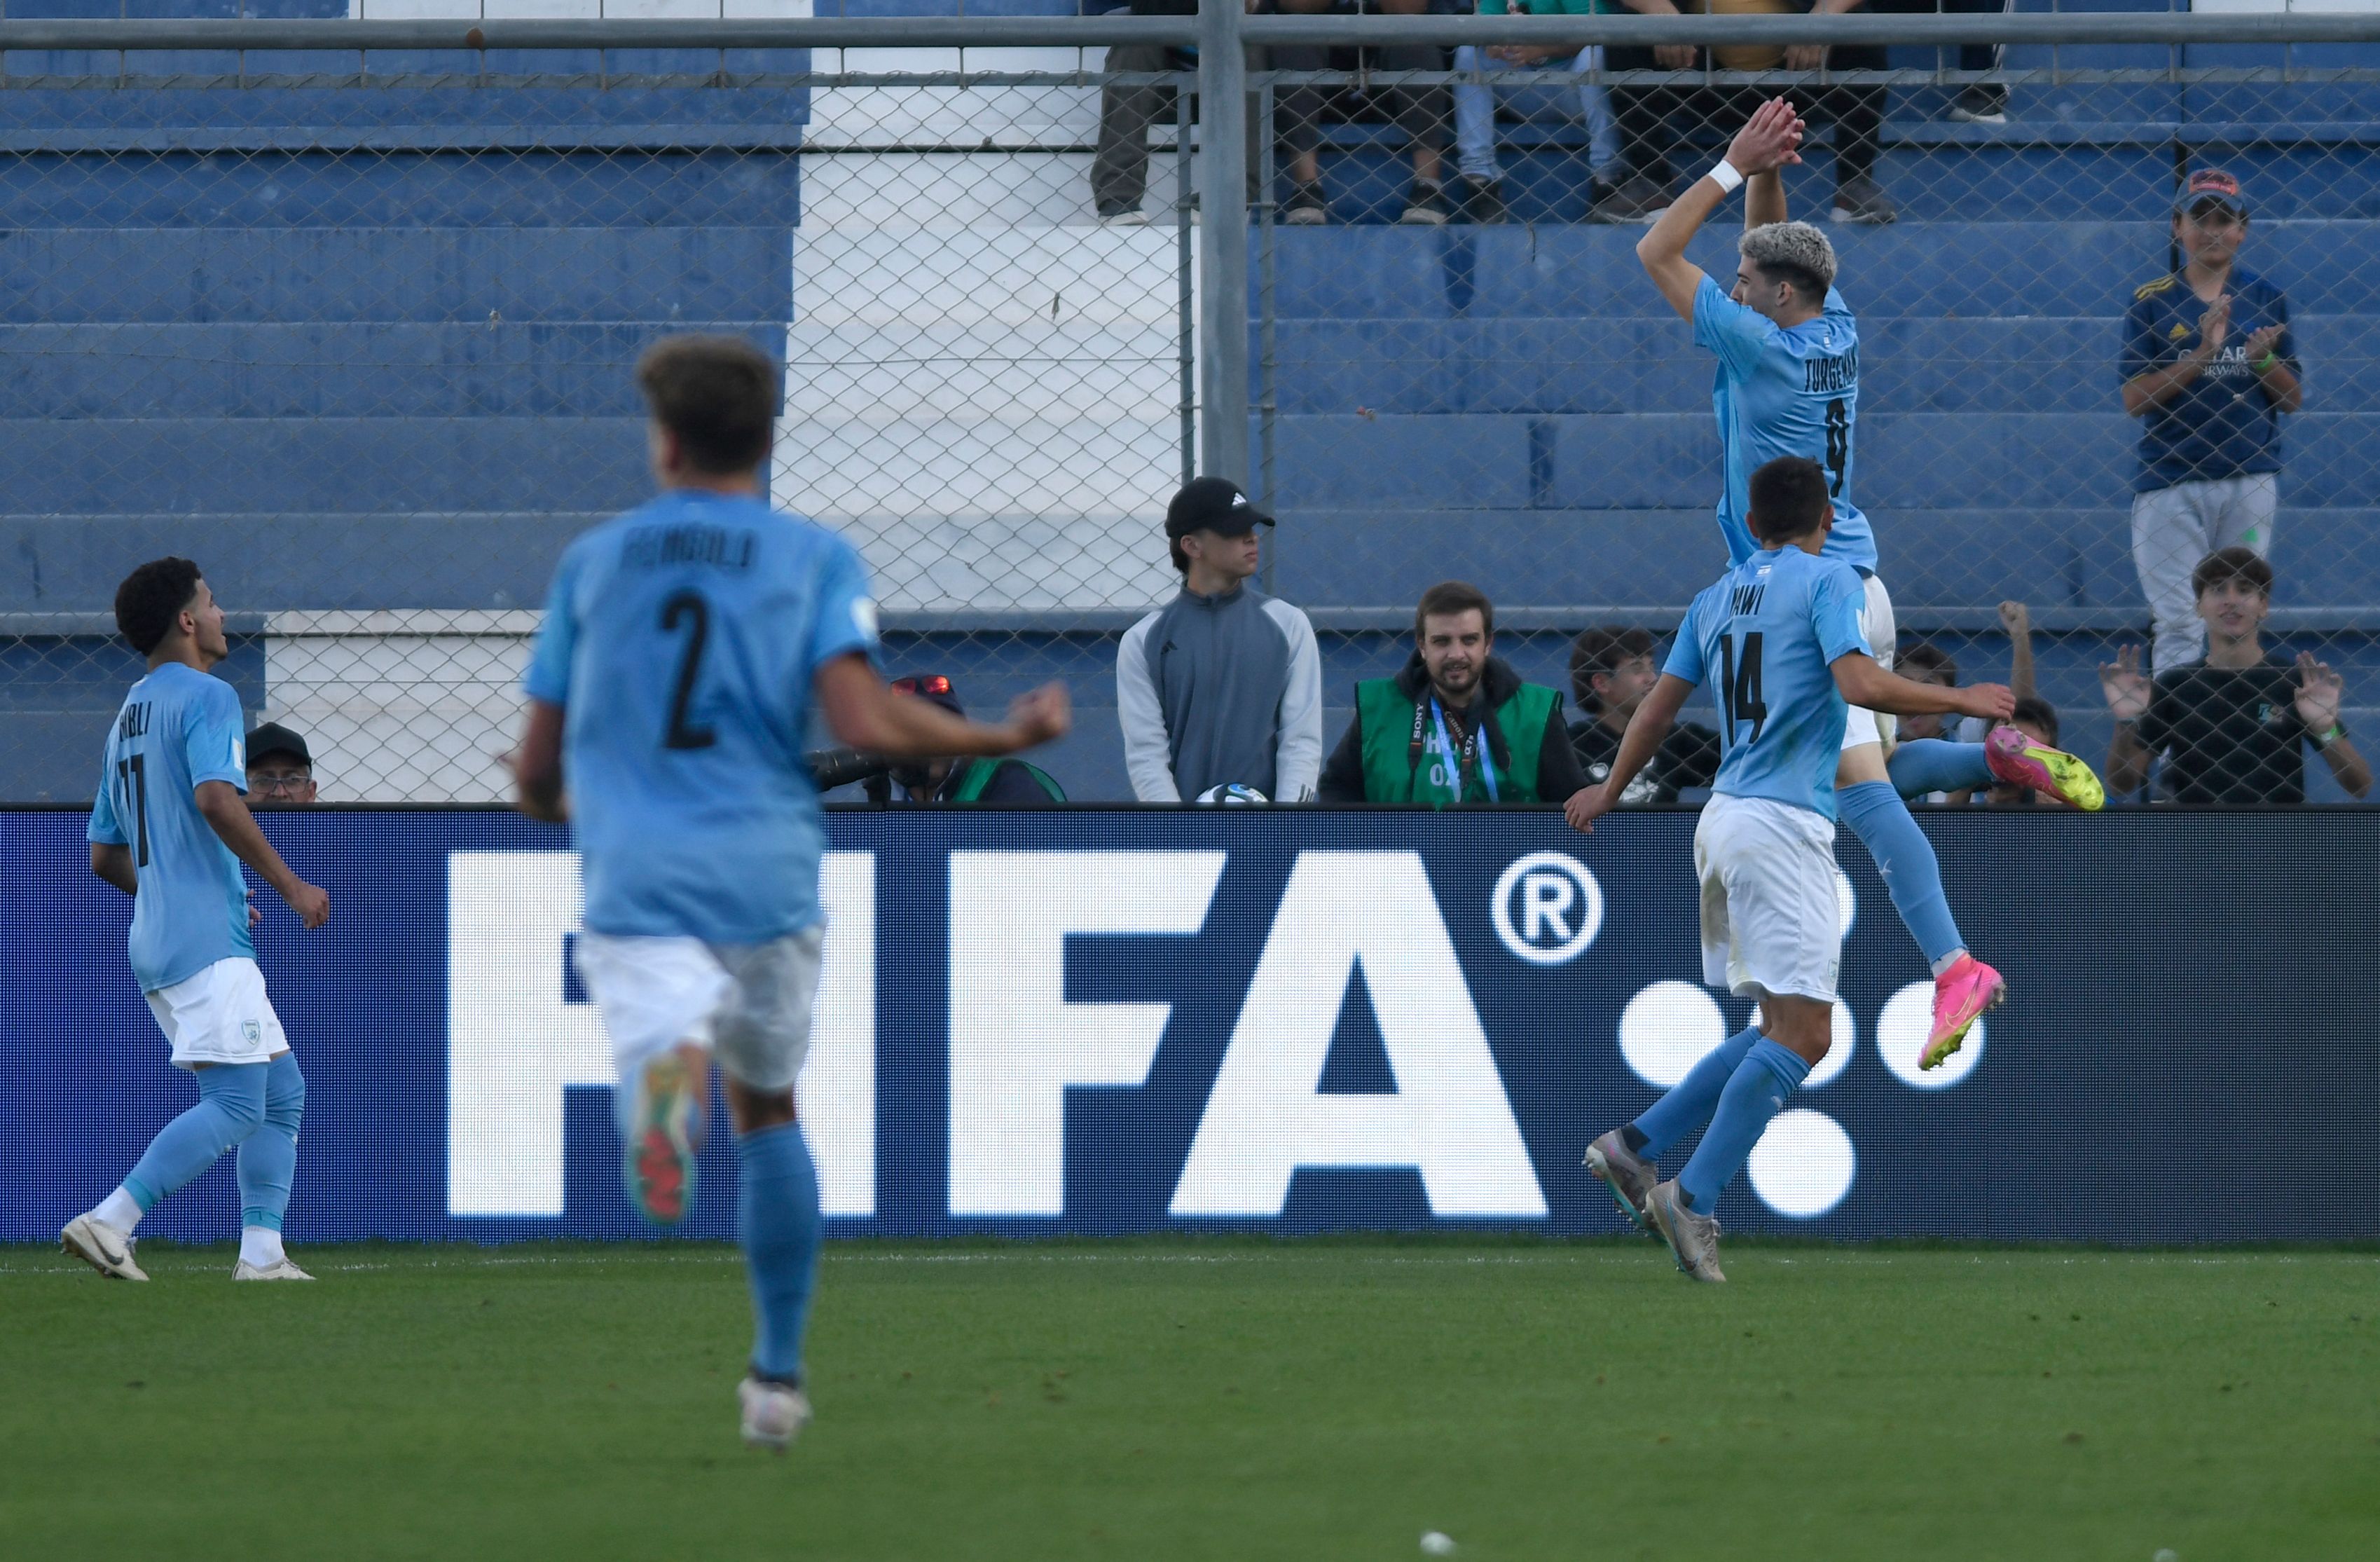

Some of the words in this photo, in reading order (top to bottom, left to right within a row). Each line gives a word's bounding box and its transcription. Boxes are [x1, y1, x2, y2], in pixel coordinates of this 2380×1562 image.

[2203, 364, 2248, 376] IRWAYS
[1825, 397, 1850, 498] 9
[663, 589, 717, 749] 2
[1720, 631, 1768, 748] 14
[1413, 702, 1424, 739] SONY
[1445, 711, 1464, 739] Canon
